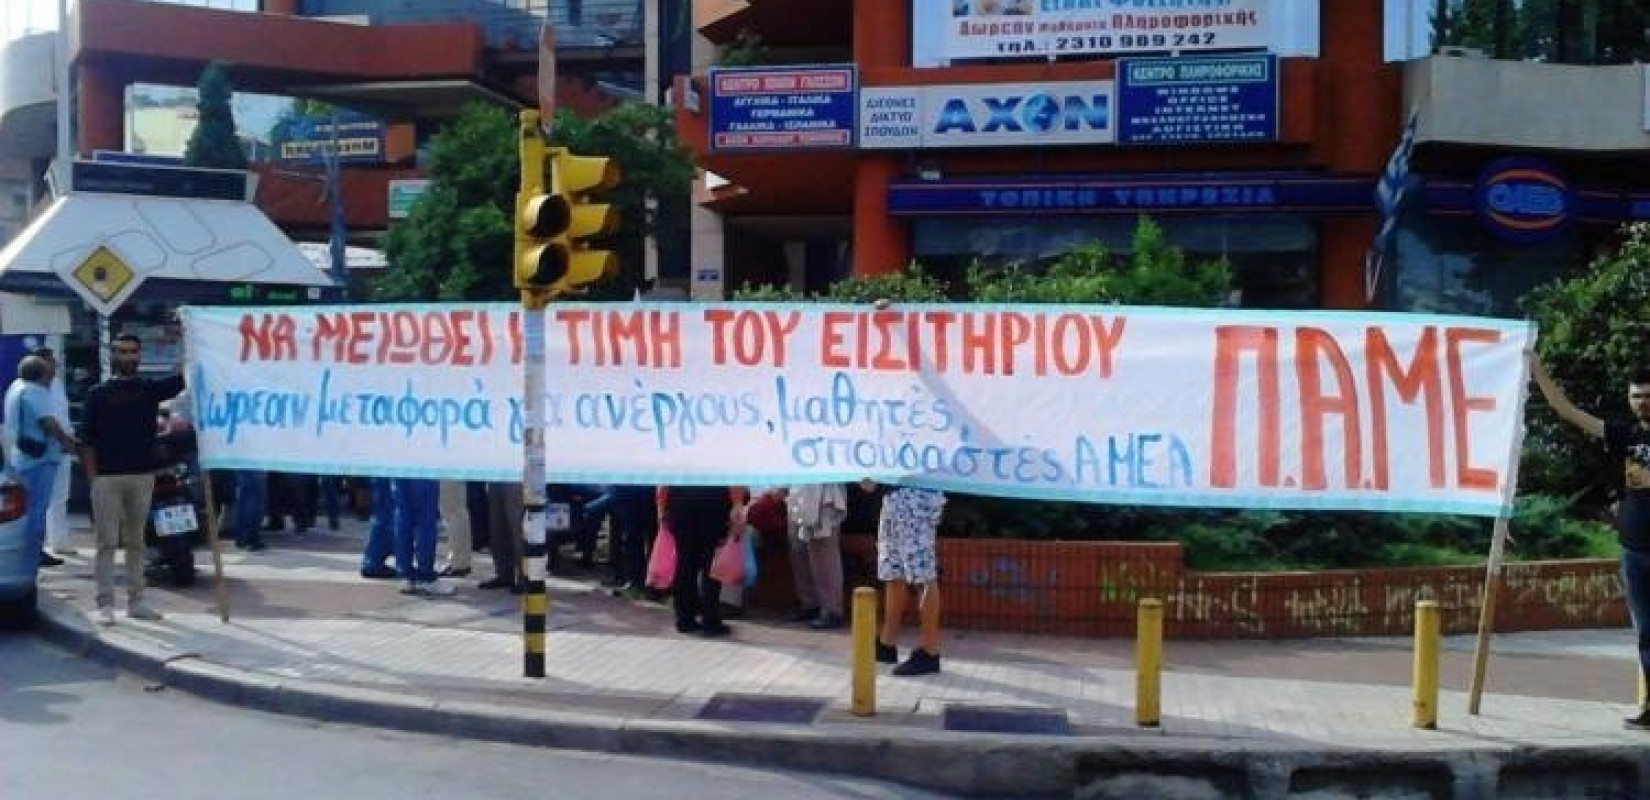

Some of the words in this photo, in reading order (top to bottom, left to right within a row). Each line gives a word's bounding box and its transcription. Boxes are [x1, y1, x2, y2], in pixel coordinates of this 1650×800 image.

[980, 190, 1096, 208] ΤΟΠΙΚΗ
[1114, 186, 1276, 206] ΥΠΗΡΕΣΙΑ
[238, 312, 298, 364] ΝΑ
[313, 309, 494, 367] ΜΕΙΩΘΕΙ
[555, 308, 682, 369] ΤΙΜΗ
[704, 309, 801, 368] ΤΟΥ
[821, 311, 1128, 379] ΕΙΣΙΤΗΡΙΟΥ
